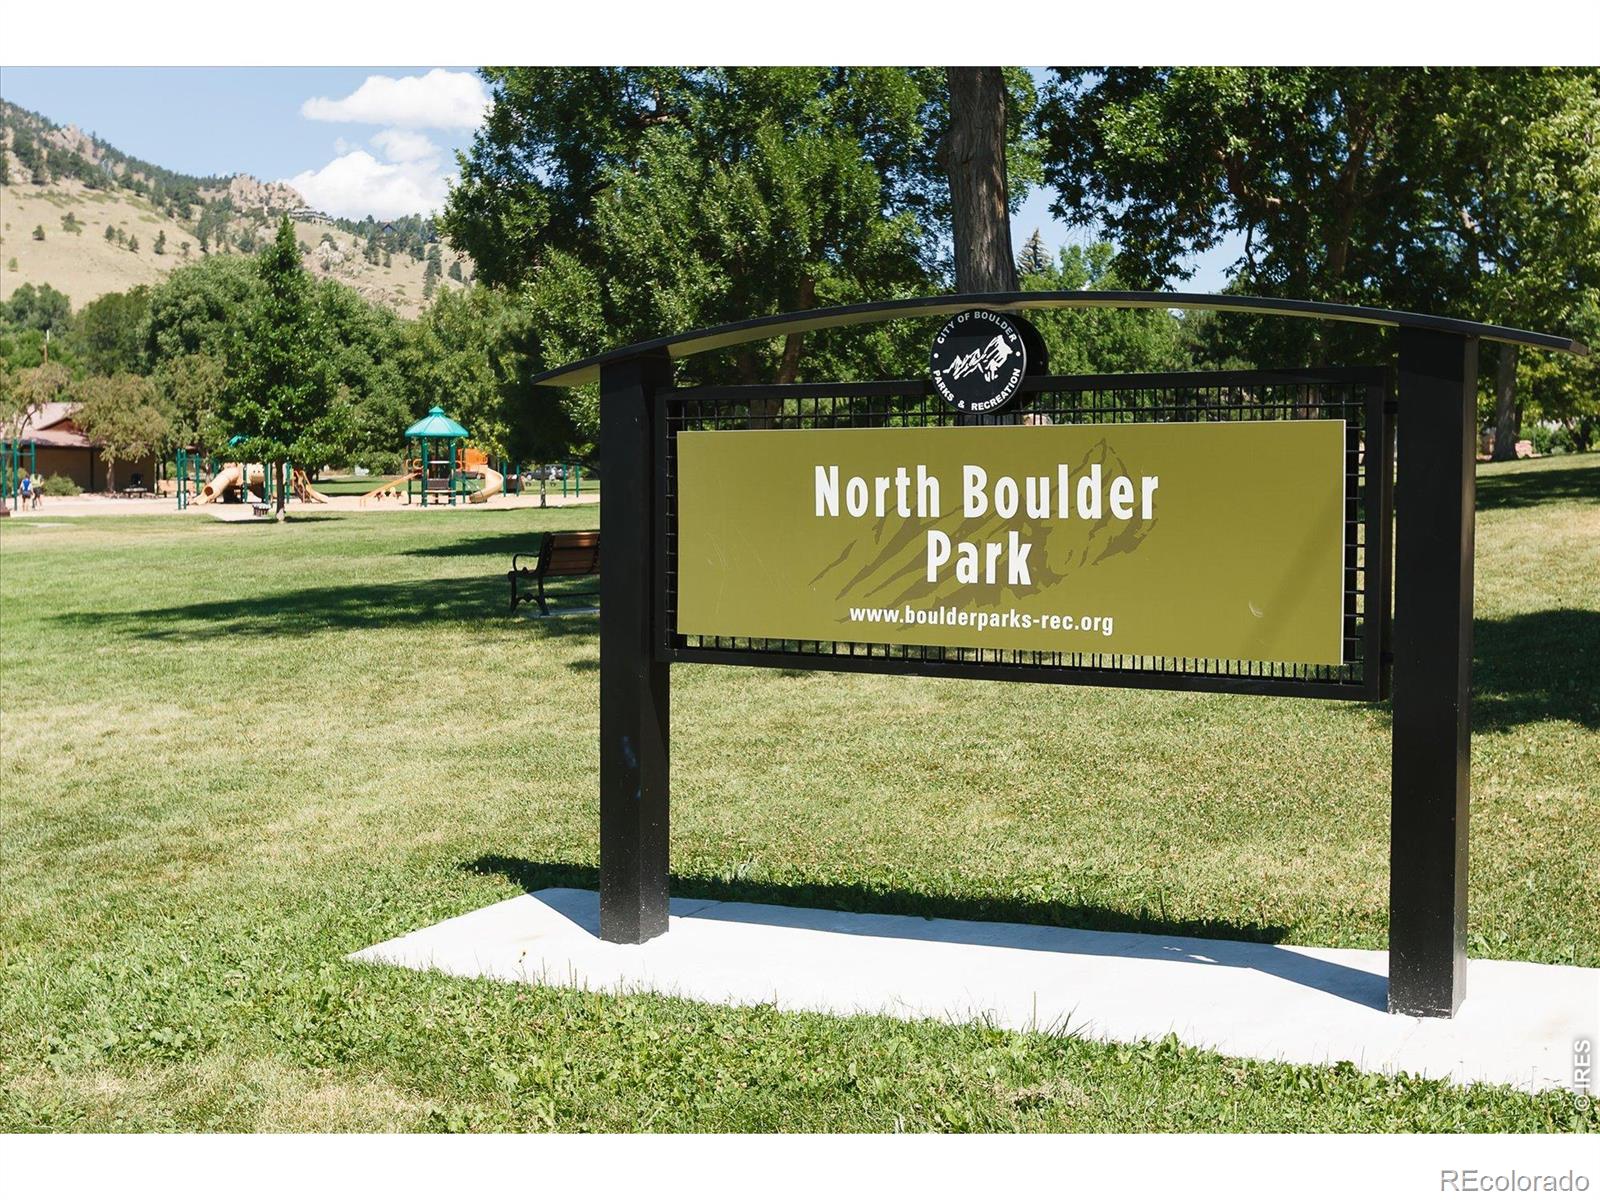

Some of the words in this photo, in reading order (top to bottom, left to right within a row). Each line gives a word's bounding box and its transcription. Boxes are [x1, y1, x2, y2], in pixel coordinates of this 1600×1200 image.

[937, 321, 955, 344] CITY
[957, 313, 970, 323] OF
[974, 311, 1017, 342] BOULDER
[933, 370, 954, 401] PARKS
[958, 400, 965, 408] &
[971, 368, 1021, 411] RECREATION
[815, 464, 940, 519] North
[963, 463, 1159, 520] Boulder
[926, 530, 1033, 586] Park
[850, 605, 1114, 636] www.boulderparks-rec.org
